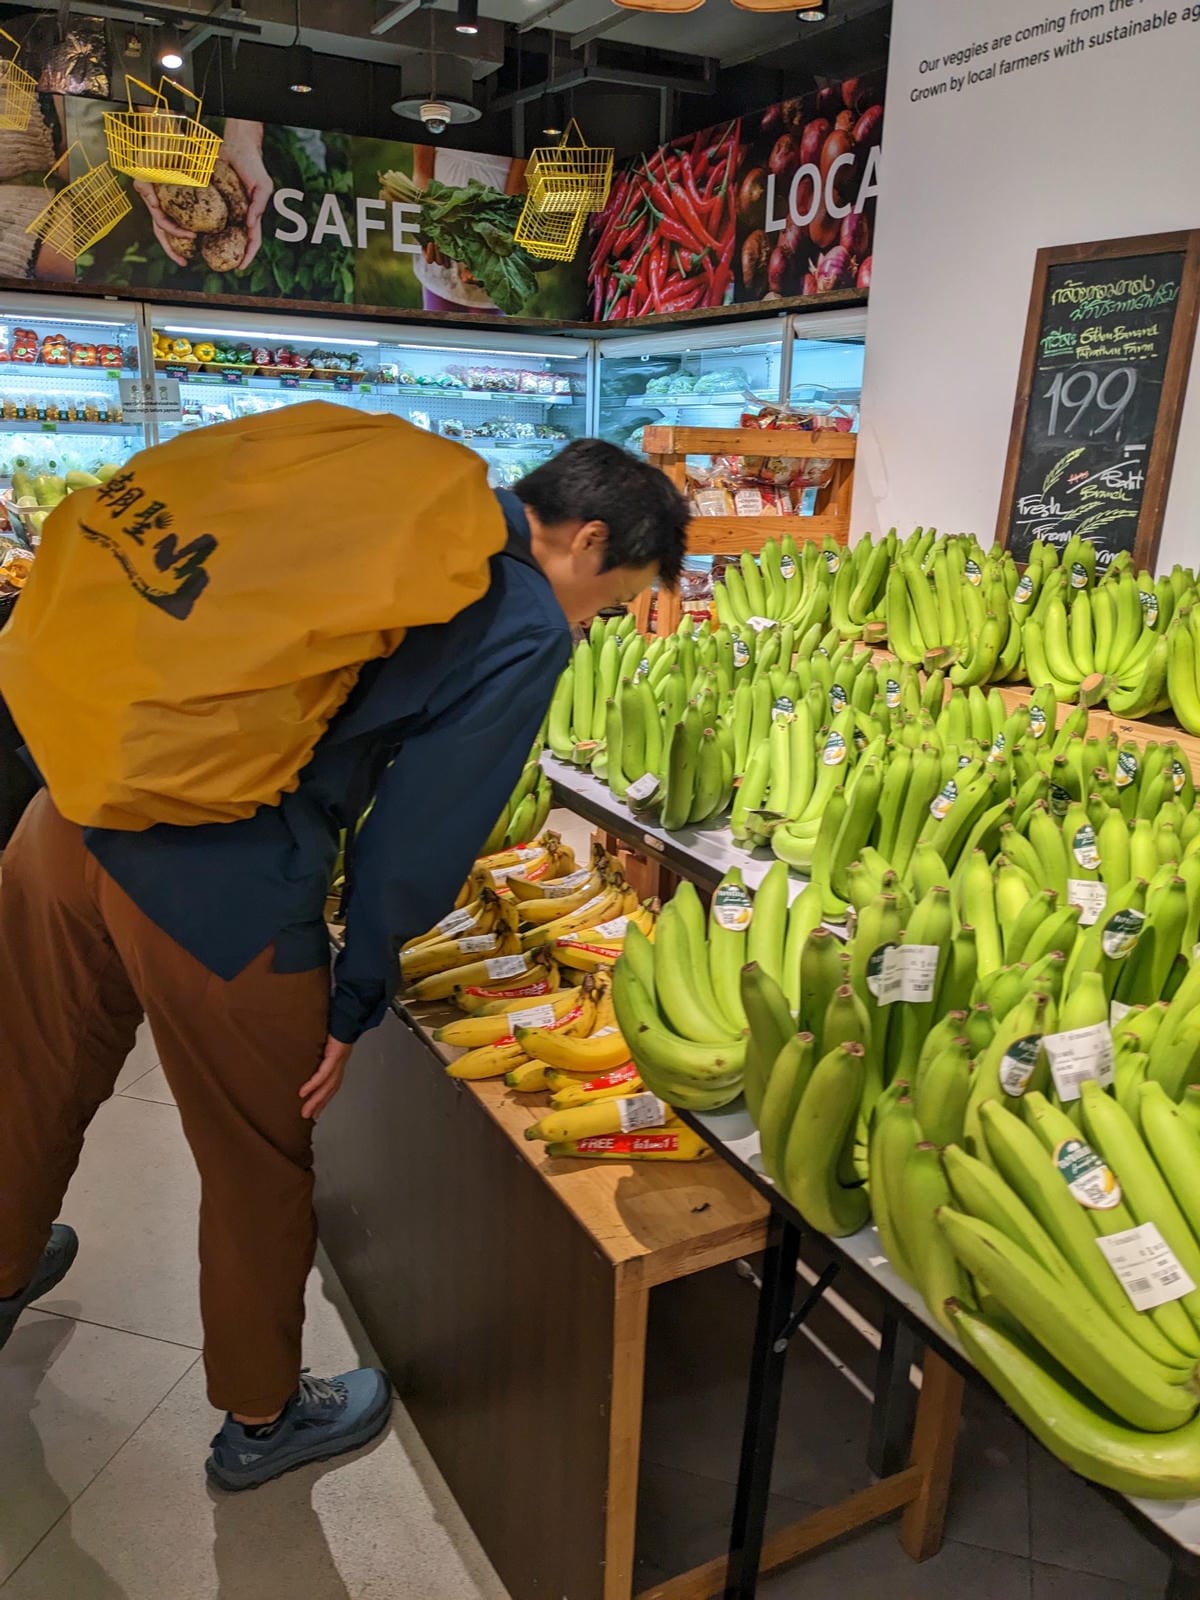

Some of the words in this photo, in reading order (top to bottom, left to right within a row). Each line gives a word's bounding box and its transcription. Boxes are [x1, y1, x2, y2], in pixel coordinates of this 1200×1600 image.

[910, 81, 947, 102] Grown
[950, 74, 965, 92] by
[967, 63, 997, 85] local
[999, 47, 1050, 75] farmers
[1053, 36, 1085, 59] with
[1088, 10, 1177, 48] sustainable
[919, 57, 940, 74] Our
[943, 40, 989, 66] veggies
[991, 33, 1012, 50] are
[1015, 18, 1066, 43] coming
[1070, 3, 1105, 26] from
[1108, 0, 1134, 13] the
[272, 187, 423, 254] SAFE
[1017, 494, 1073, 517] Fresh
